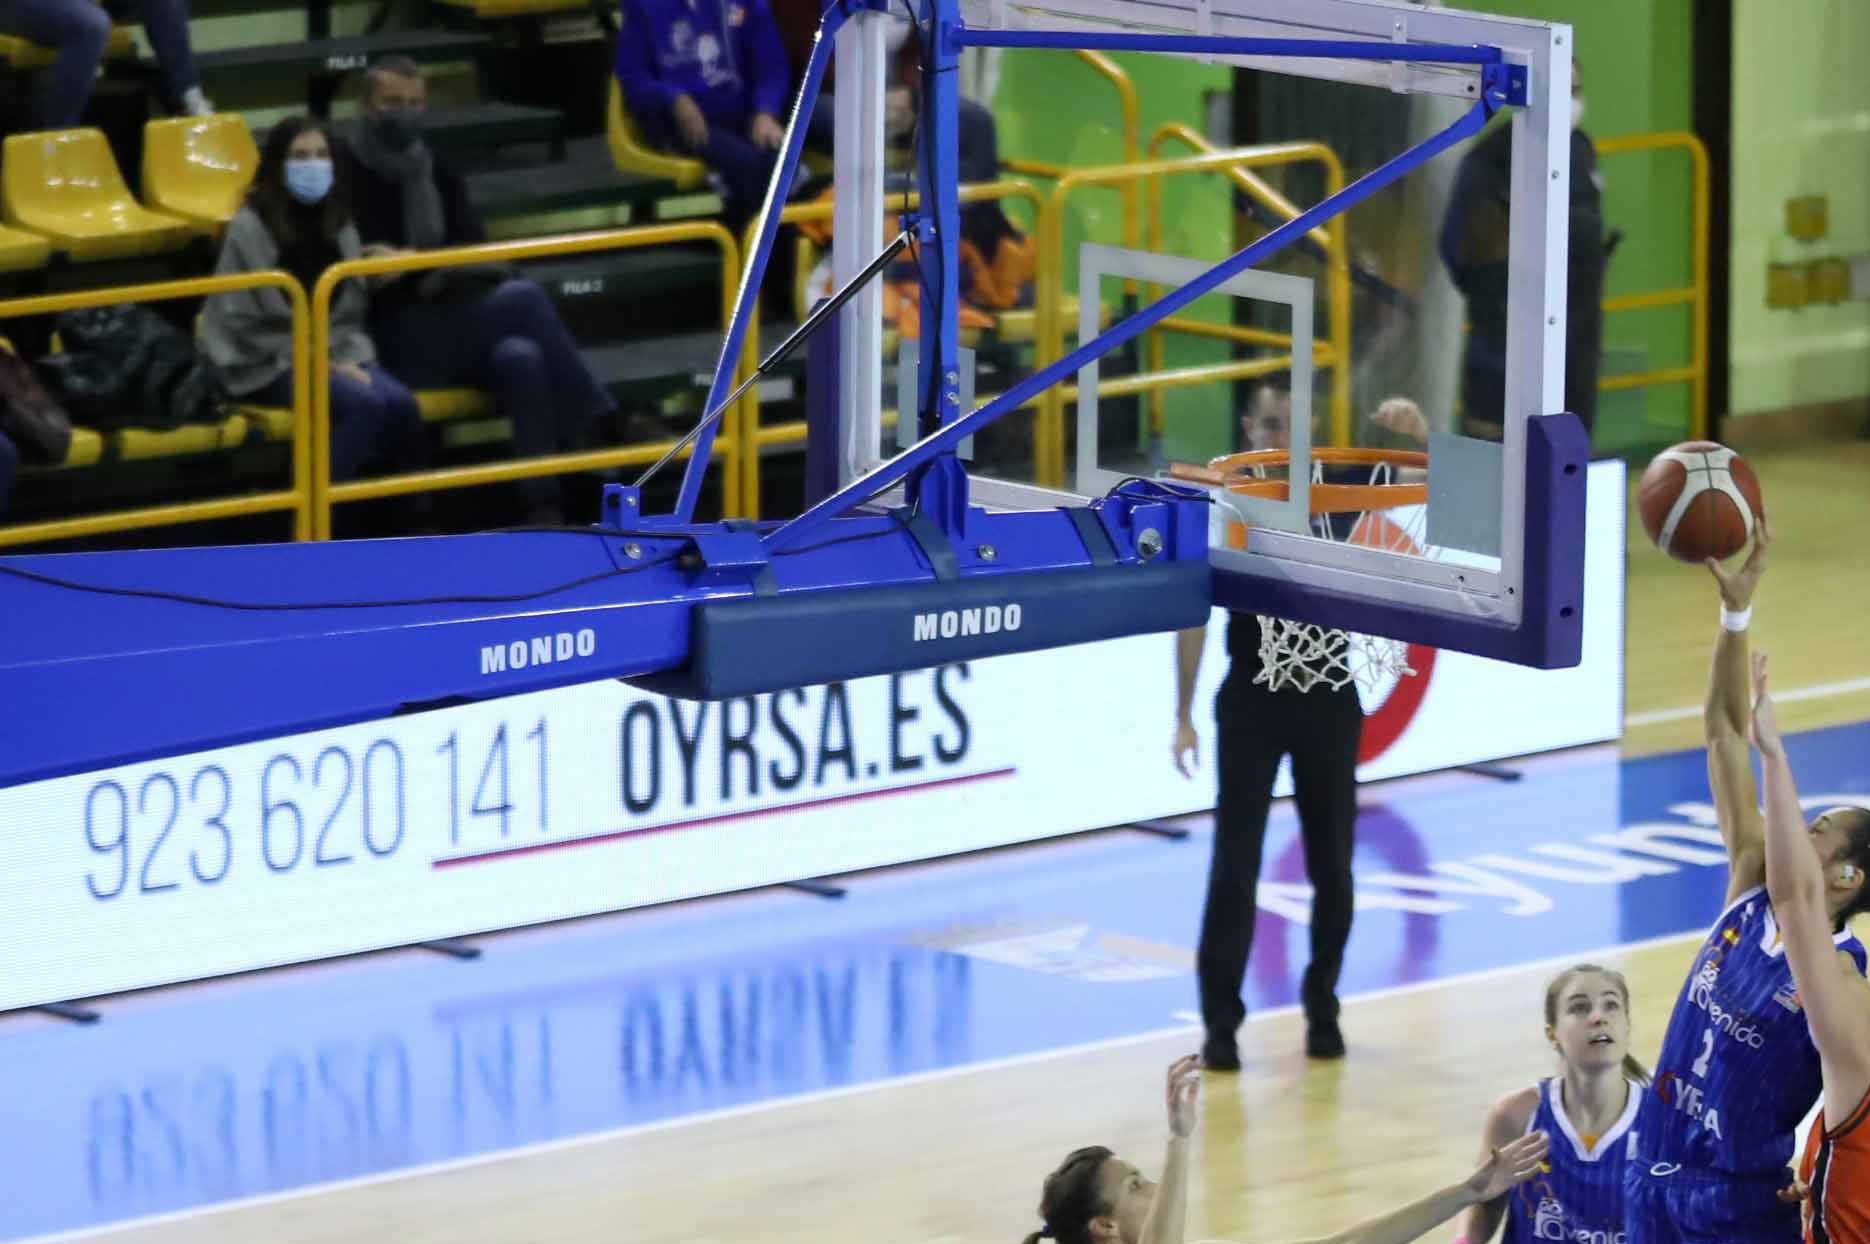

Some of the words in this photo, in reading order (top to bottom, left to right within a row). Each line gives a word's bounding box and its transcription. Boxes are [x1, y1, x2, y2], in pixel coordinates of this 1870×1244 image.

[914, 603, 1022, 641] MONDO
[481, 628, 596, 674] MONDO
[83, 765, 235, 900] 923
[260, 738, 405, 872] 620
[436, 716, 551, 846] 141
[619, 662, 971, 813] OYRSA.ES
[1691, 1028, 1714, 1078] 2
